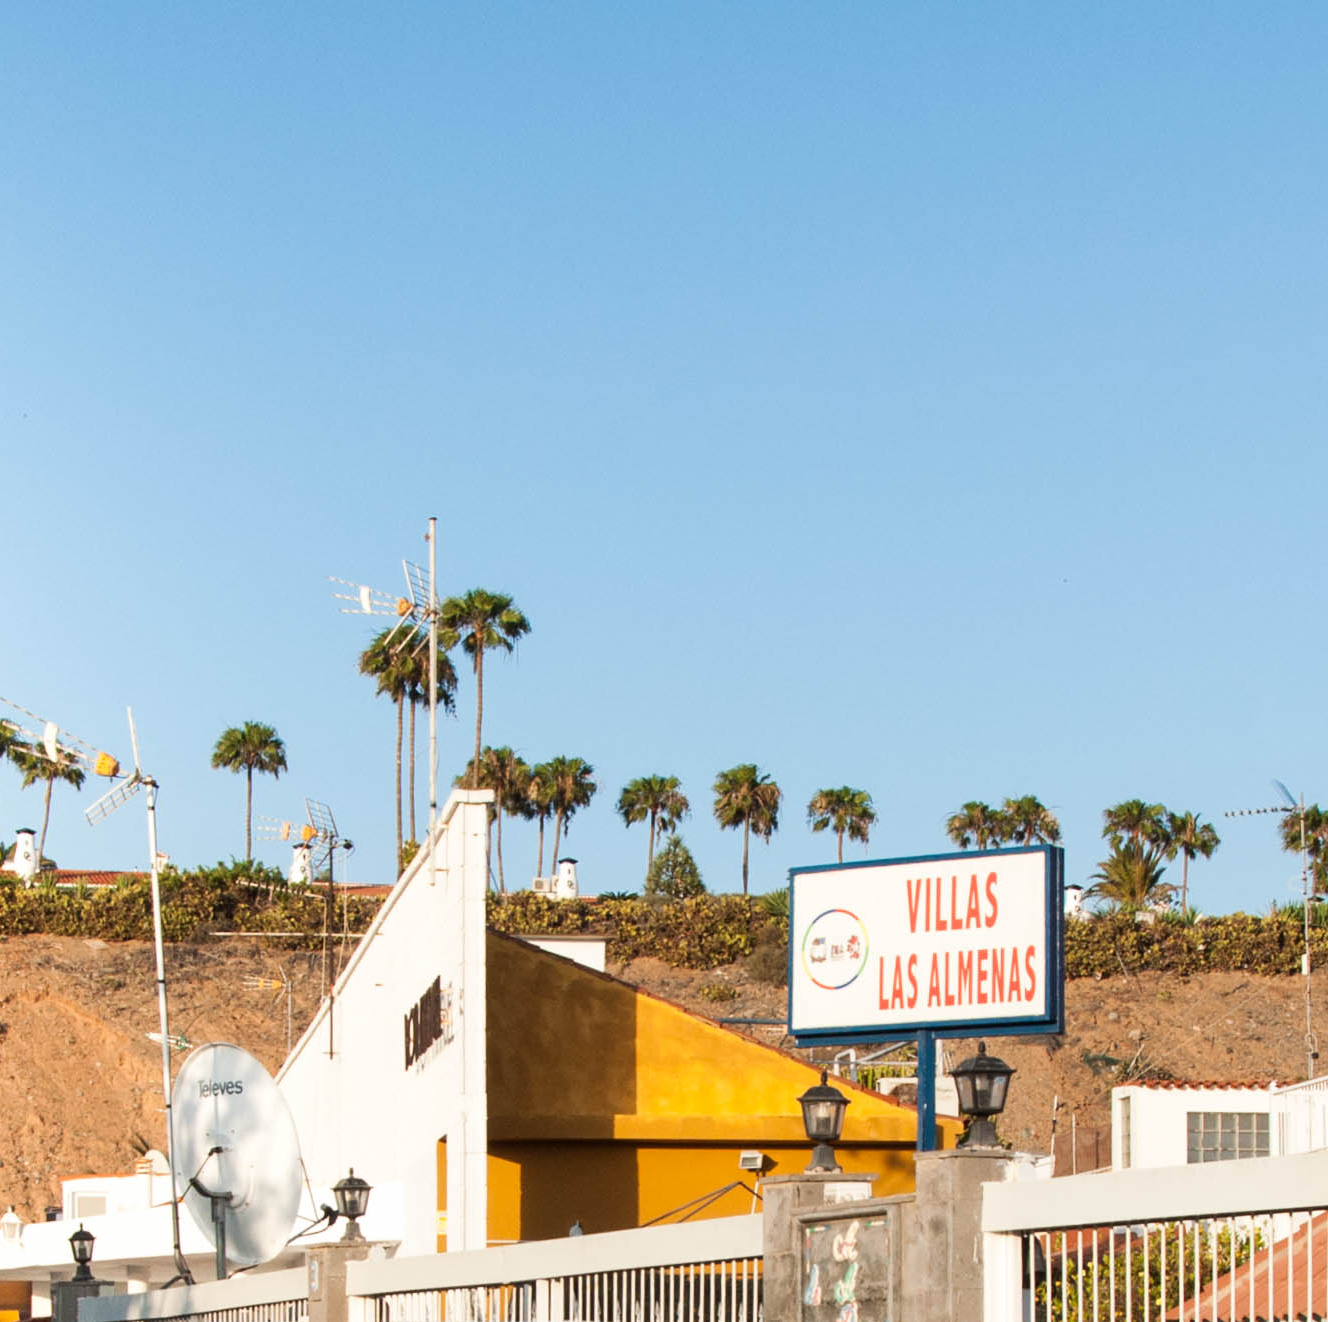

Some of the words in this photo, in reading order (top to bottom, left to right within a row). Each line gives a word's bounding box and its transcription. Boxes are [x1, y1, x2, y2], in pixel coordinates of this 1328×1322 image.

[906, 871, 999, 934] VILLAS
[878, 953, 919, 1011] LAS
[926, 944, 1037, 1008] ALMENAS
[197, 1079, 244, 1098] Televes
